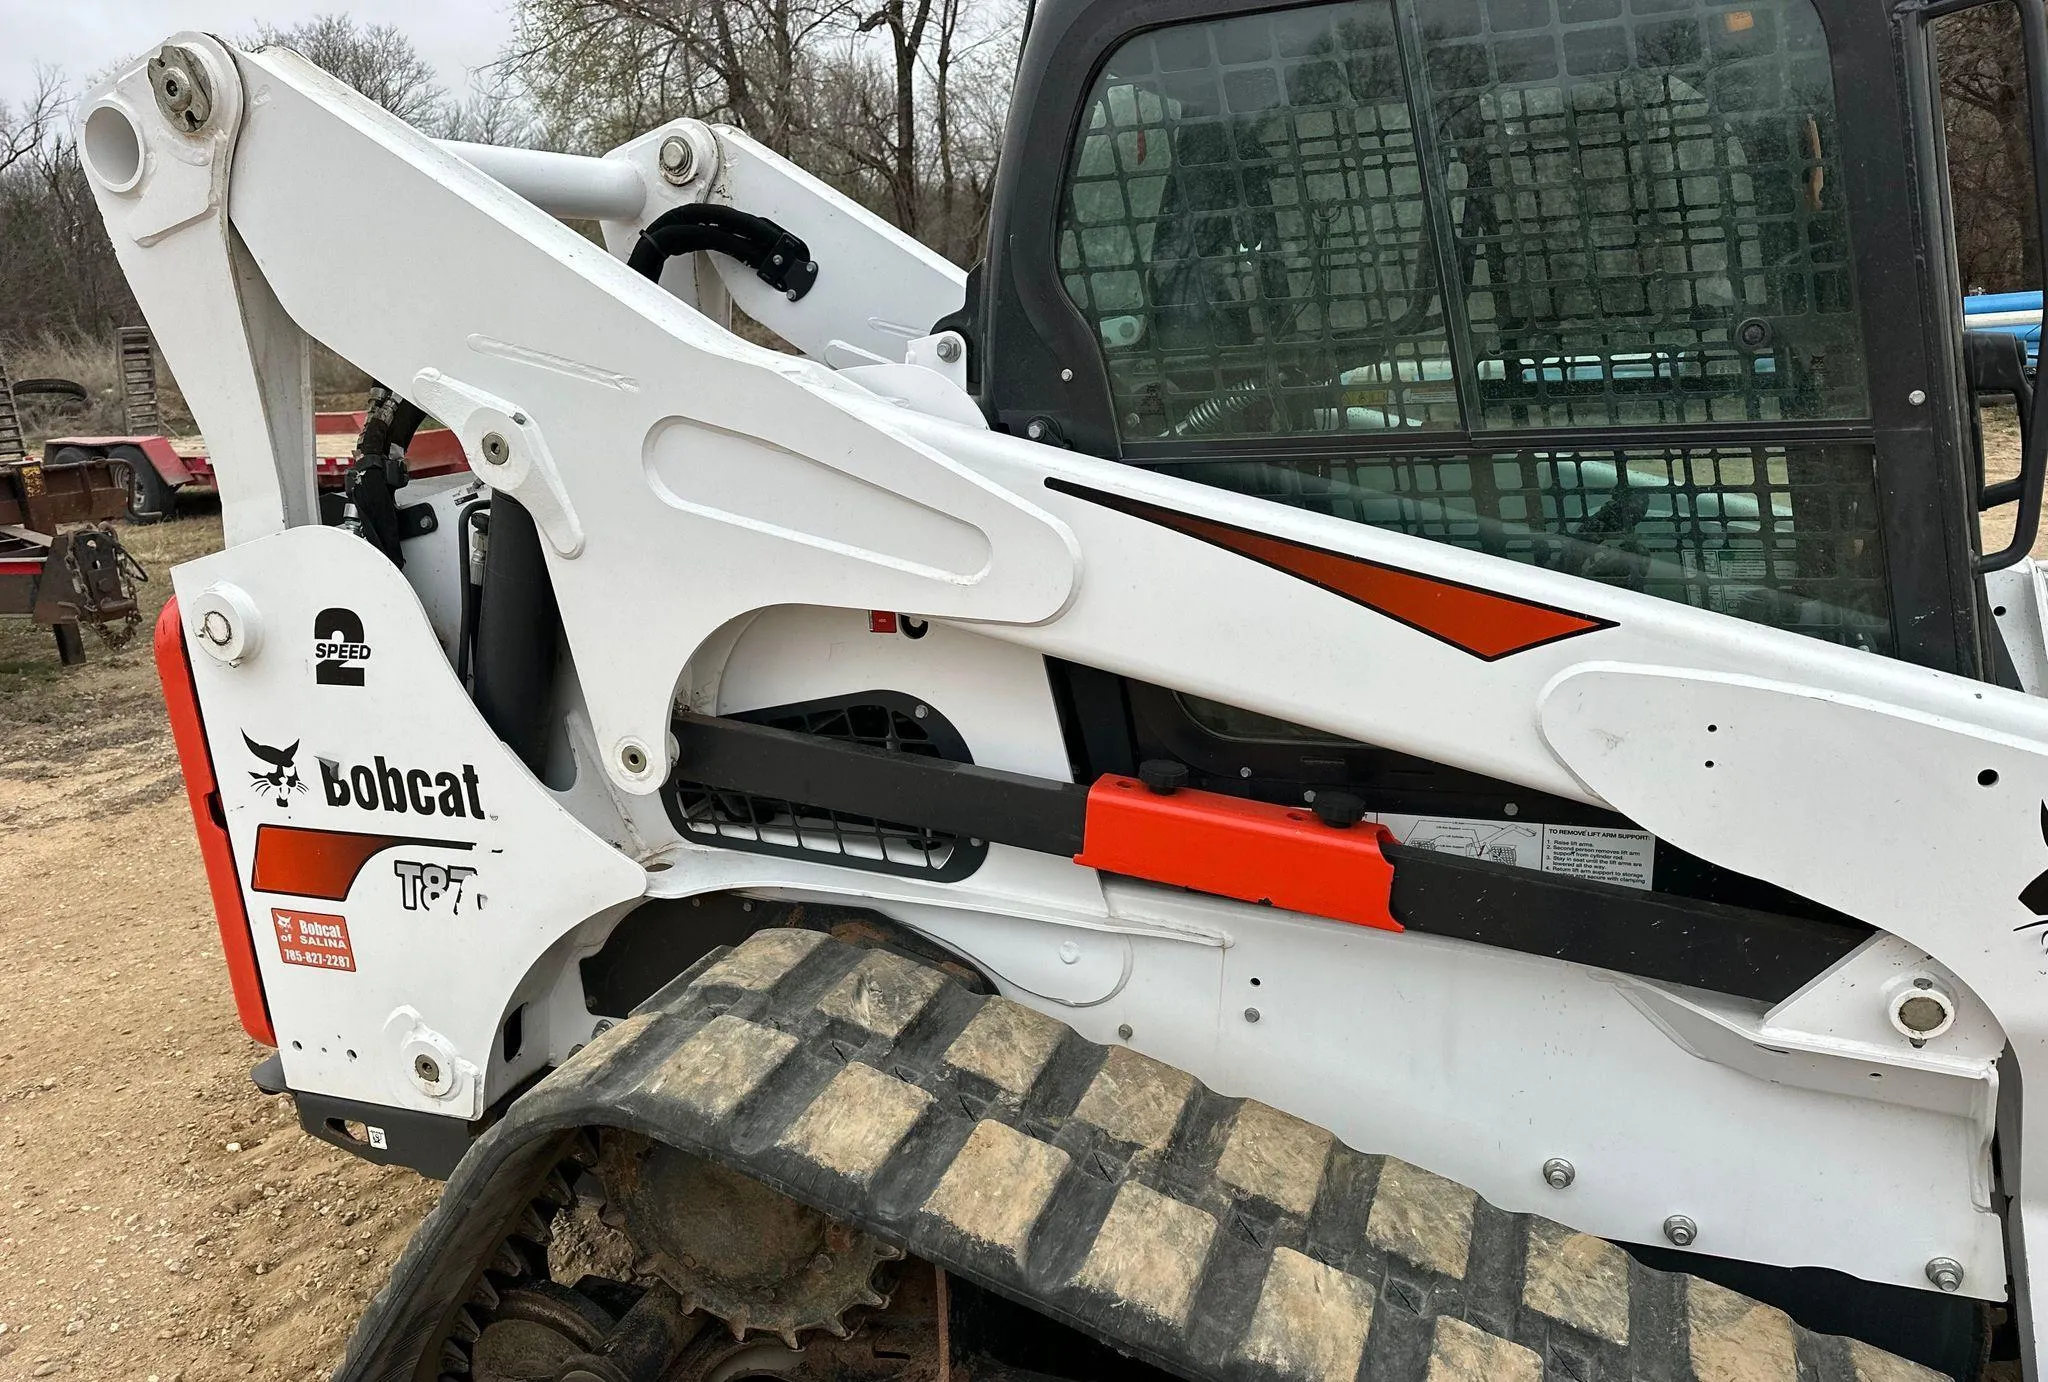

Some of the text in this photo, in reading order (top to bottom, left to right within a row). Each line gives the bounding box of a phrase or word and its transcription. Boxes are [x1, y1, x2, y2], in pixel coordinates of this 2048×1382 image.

[314, 607, 365, 687] 2
[315, 642, 372, 660] SPEED
[315, 755, 486, 820] Bobcat
[1559, 829, 1587, 837] REMOVE
[1620, 877, 1646, 885] clamping
[299, 920, 342, 939] Bobcat
[280, 934, 348, 950] of SALINA
[284, 948, 351, 969] 785-827-2287
